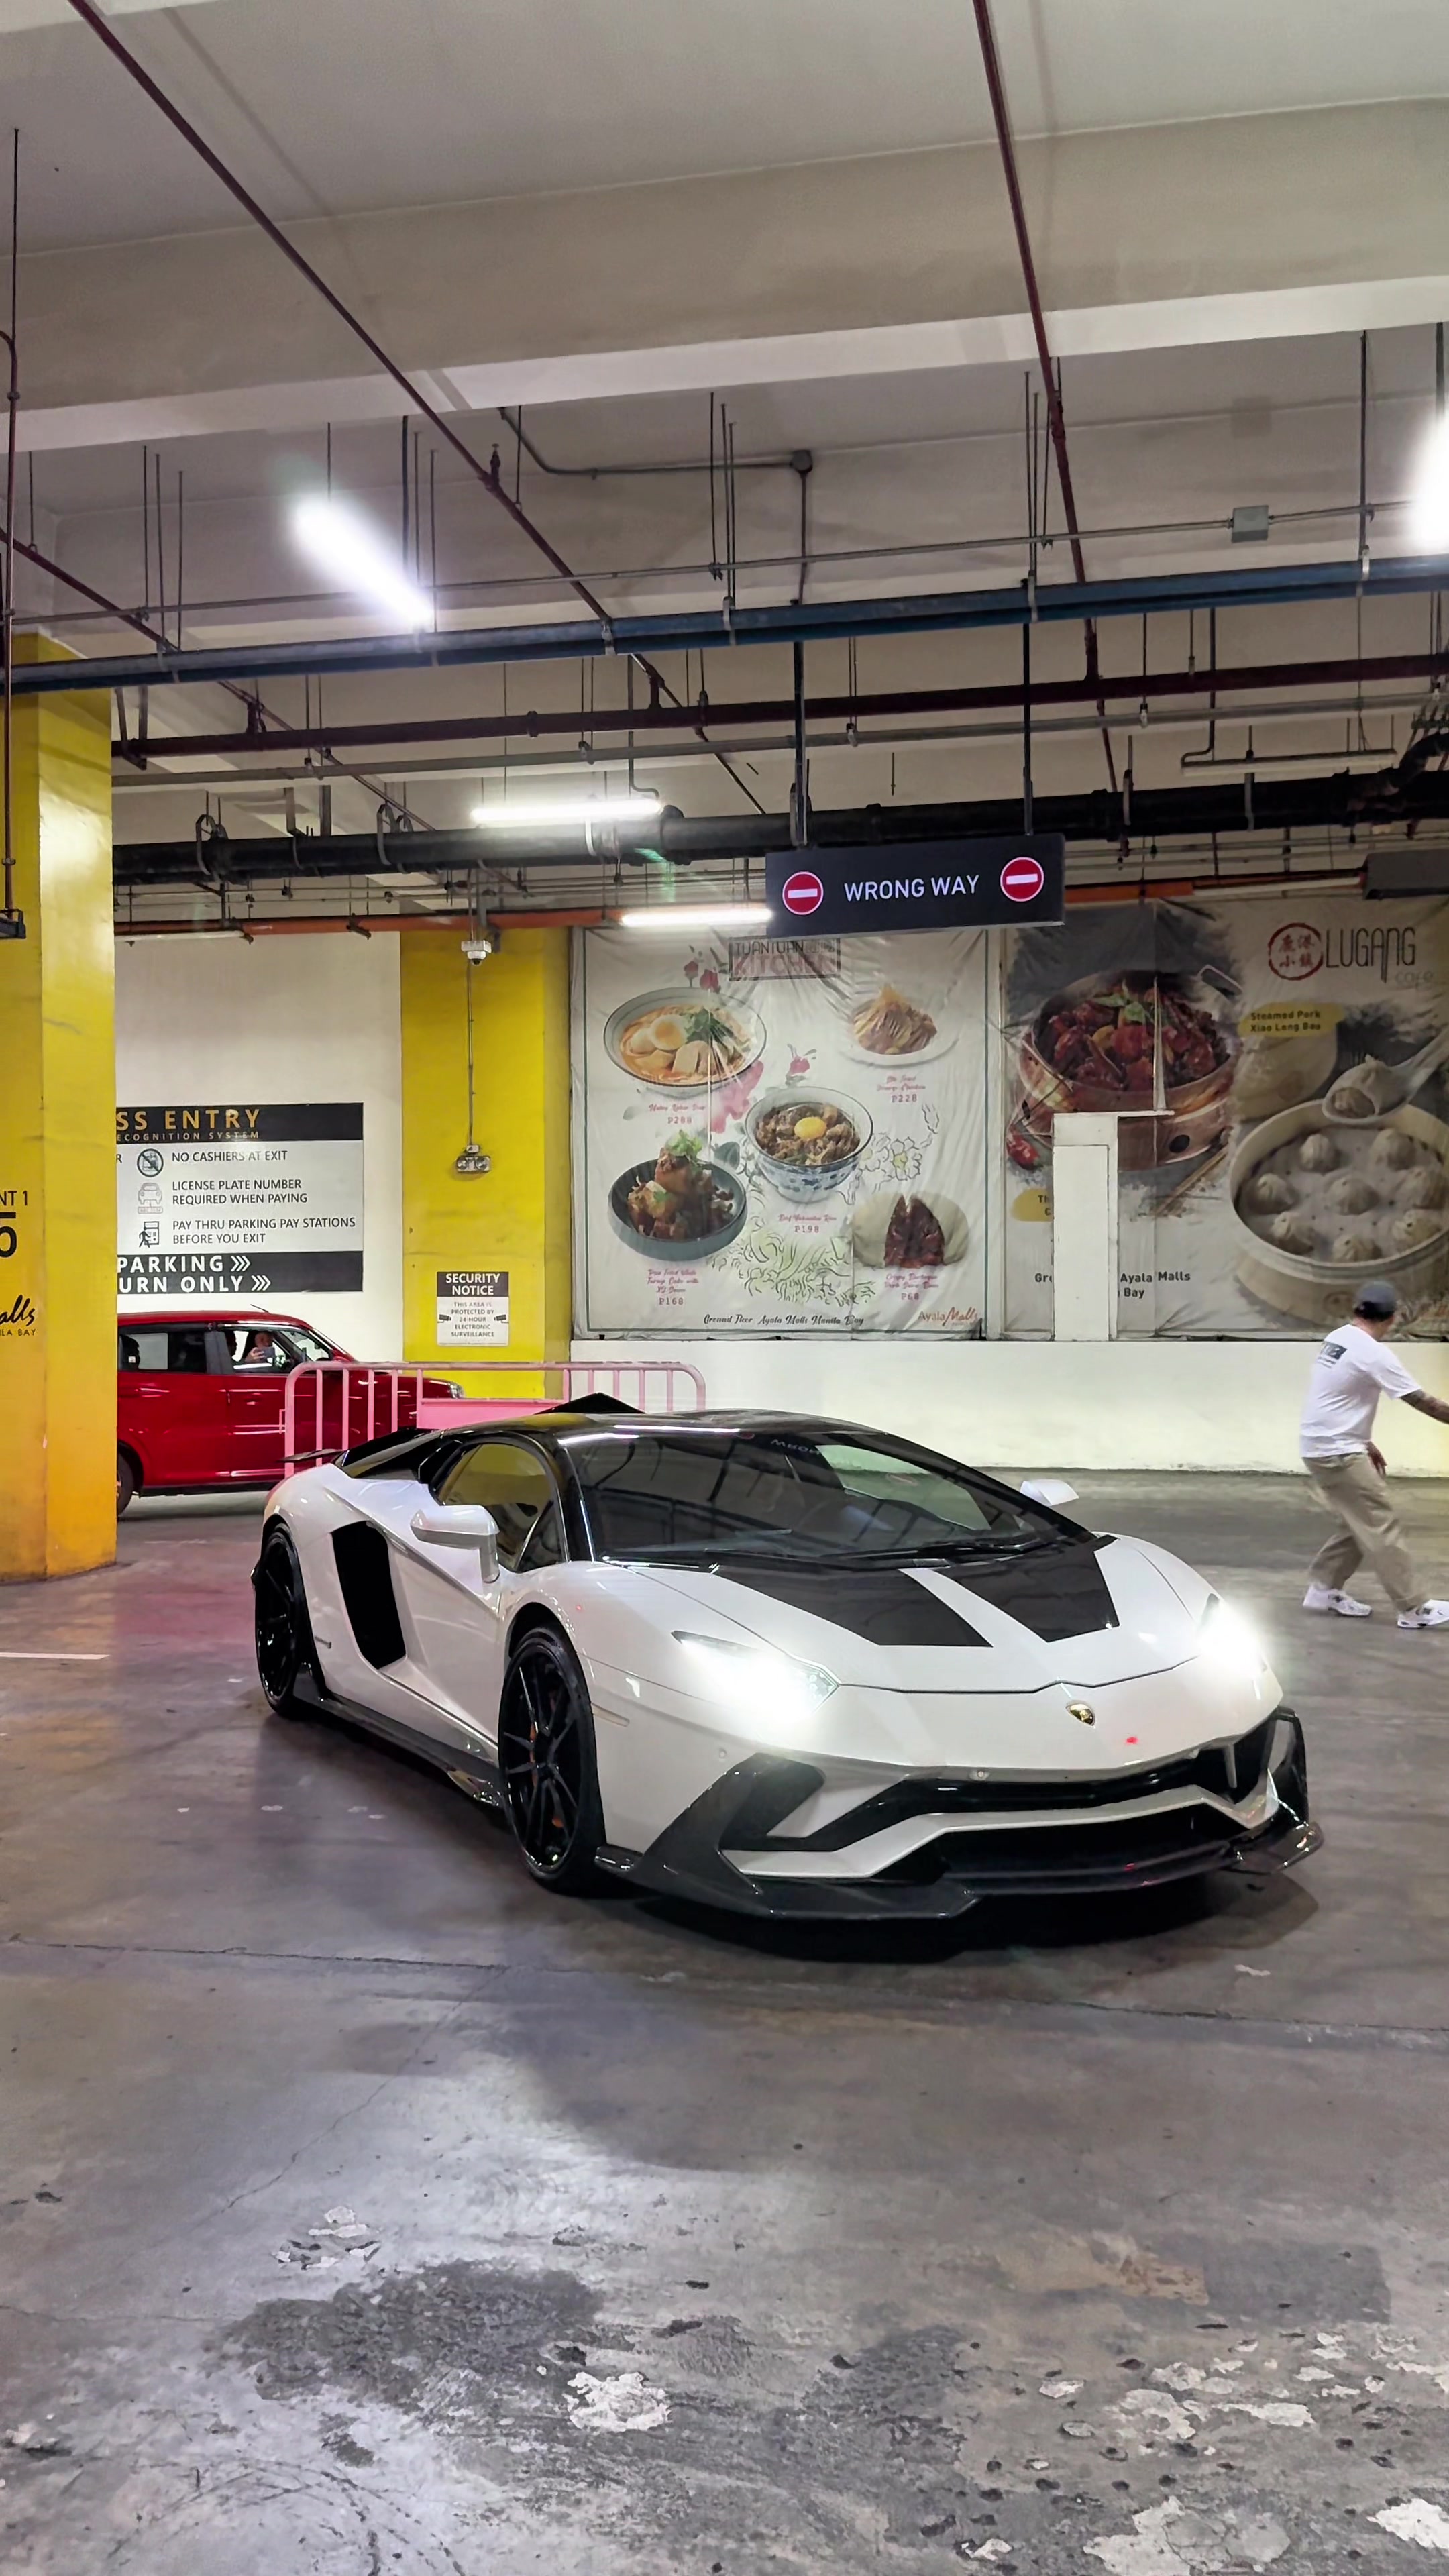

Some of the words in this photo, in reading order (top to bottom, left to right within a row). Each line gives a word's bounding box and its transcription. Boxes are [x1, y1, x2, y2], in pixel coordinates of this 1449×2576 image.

[845, 879, 924, 902] WRONG
[930, 874, 980, 896] WAY
[1326, 927, 1416, 983] LUGANG
[1250, 1011, 1294, 1020] Steamed
[1297, 1010, 1320, 1019] Pork
[164, 1108, 260, 1130] ENTRY
[209, 1131, 259, 1139] SYSTEM
[172, 1152, 189, 1162] NO
[192, 1152, 245, 1162] CASHIERS
[248, 1151, 261, 1161] AT
[265, 1150, 288, 1161] EXIT
[172, 1180, 215, 1191] LICENSE
[219, 1179, 250, 1190] PLATE
[254, 1179, 302, 1189] NUMBER
[172, 1194, 227, 1205] REQUIRED
[230, 1193, 264, 1204] WHEN
[268, 1193, 308, 1203] PAYING
[172, 1220, 192, 1230] PAY
[195, 1219, 225, 1230] THRU
[228, 1218, 276, 1229] PARKING
[280, 1218, 299, 1228] PAY
[303, 1217, 356, 1228] STATIONS
[173, 1234, 213, 1244] BEFORE
[216, 1234, 239, 1243] YOU
[243, 1233, 266, 1243] EXIT
[117, 1255, 223, 1273] PARKING
[445, 1273, 500, 1283] SECURITY
[1120, 1273, 1152, 1284] Ayala
[1158, 1271, 1191, 1281] Malls
[180, 1275, 243, 1293] ONLY
[451, 1285, 494, 1295] NOTICE
[1124, 1287, 1145, 1299] Bay
[659, 1297, 684, 1305] P168
[757, 1314, 782, 1326] Ayala
[18, 1328, 36, 1336] BAY
